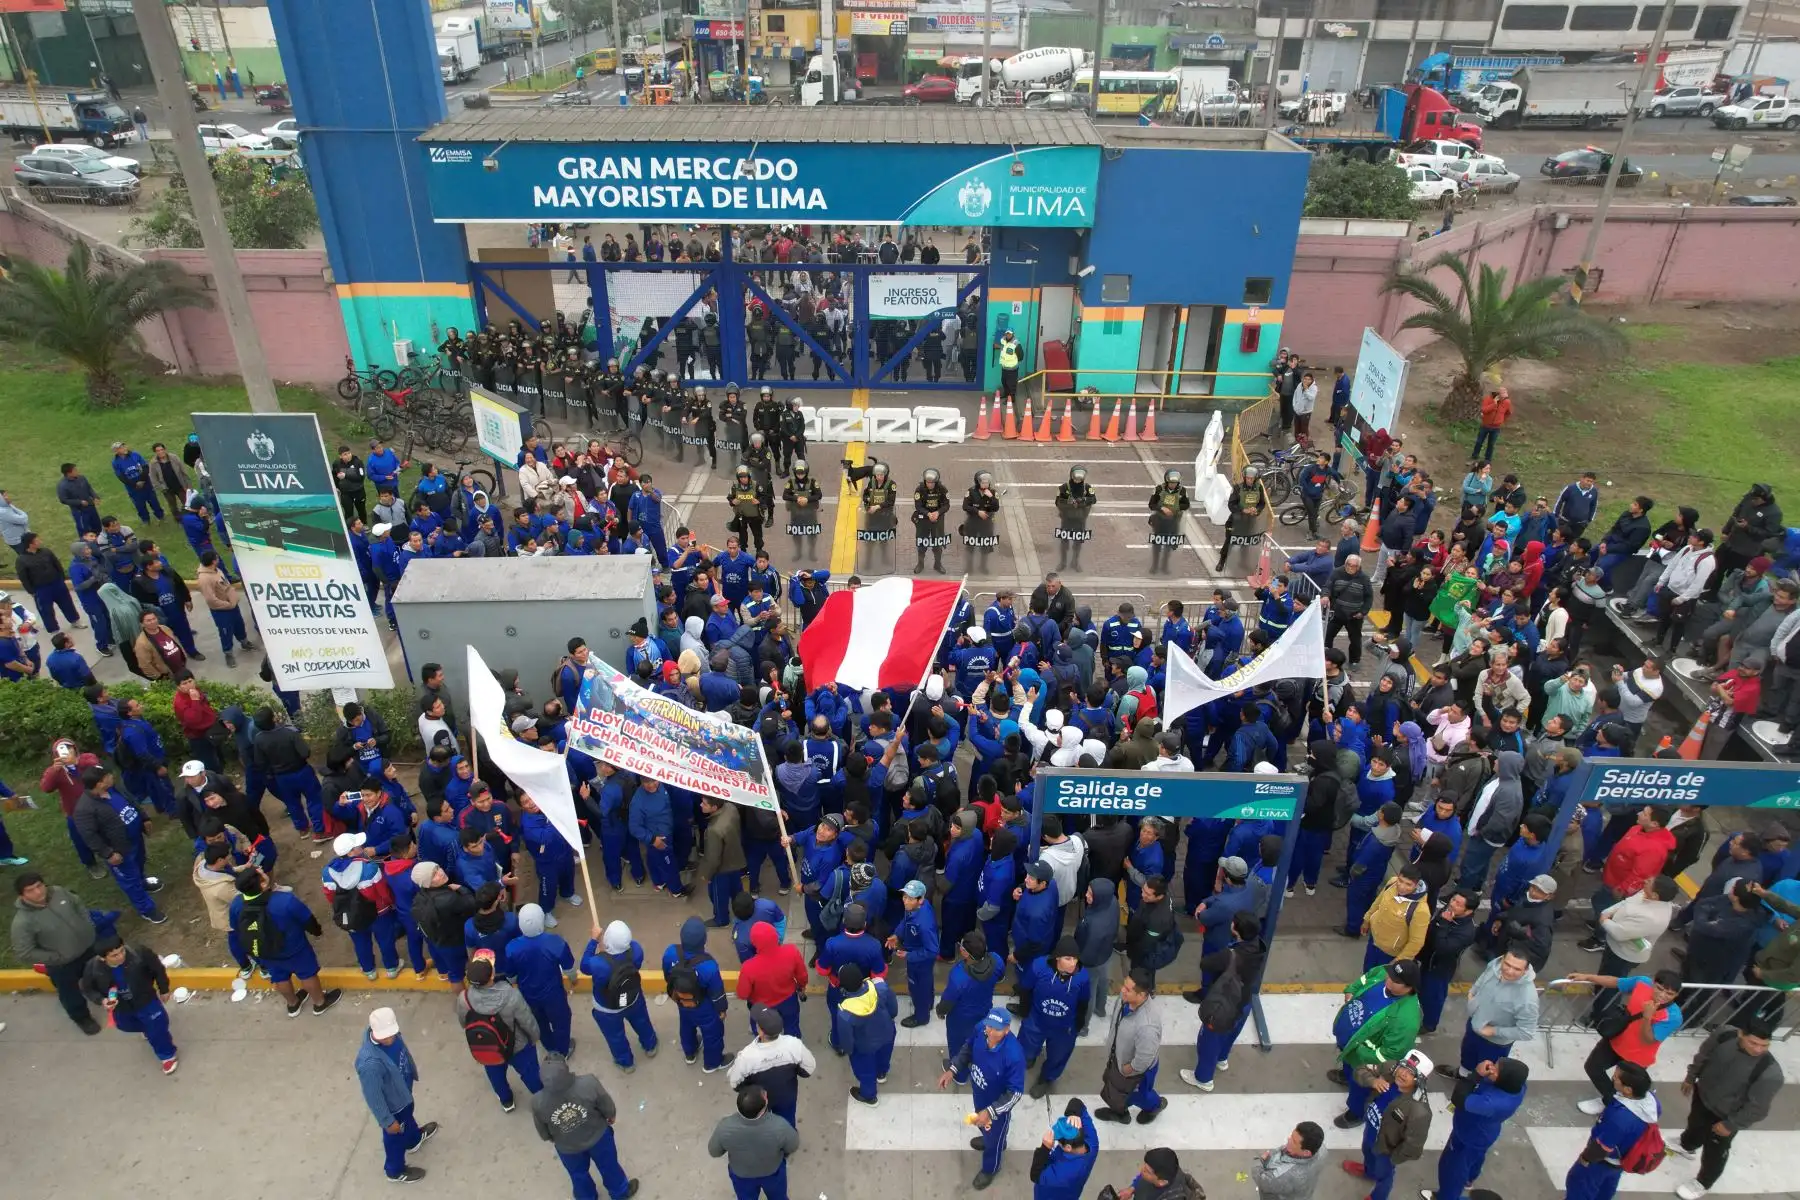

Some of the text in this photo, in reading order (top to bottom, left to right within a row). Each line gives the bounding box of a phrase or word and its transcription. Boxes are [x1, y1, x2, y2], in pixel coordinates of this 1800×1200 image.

[937, 15, 976, 25] TOLDERAS
[1018, 48, 1068, 62] POLIMIX
[558, 157, 798, 181] GRAN MERCADO
[533, 185, 828, 210] MAYORISTA DE LIMA
[1009, 196, 1086, 216] LIMA
[888, 288, 937, 297] INGRESO
[884, 297, 942, 305] PEATONAL
[682, 435, 708, 446] POLICIA
[716, 440, 742, 451] POLICIA
[239, 473, 304, 490] LIMA
[786, 524, 821, 536] POLICIA
[1055, 530, 1091, 543] POLICIA
[963, 534, 999, 547] POLICIA
[1149, 534, 1185, 546] POLICIA
[277, 566, 319, 577] NUEVO
[250, 579, 361, 602] PABELLÓN
[267, 603, 357, 618] DE FRUTAS
[337, 627, 369, 635] VENTA
[281, 658, 371, 674] SIN CORRUPCIÓN
[639, 697, 700, 732] SITRAMAN
[591, 709, 622, 727] HOY
[679, 747, 689, 759] Y
[604, 749, 731, 799] DE SUS AFILIADOS
[1602, 769, 1705, 786] Salida de
[1059, 780, 1163, 797] Salida de
[1595, 786, 1699, 800] personas
[1058, 797, 1147, 810] carretas
